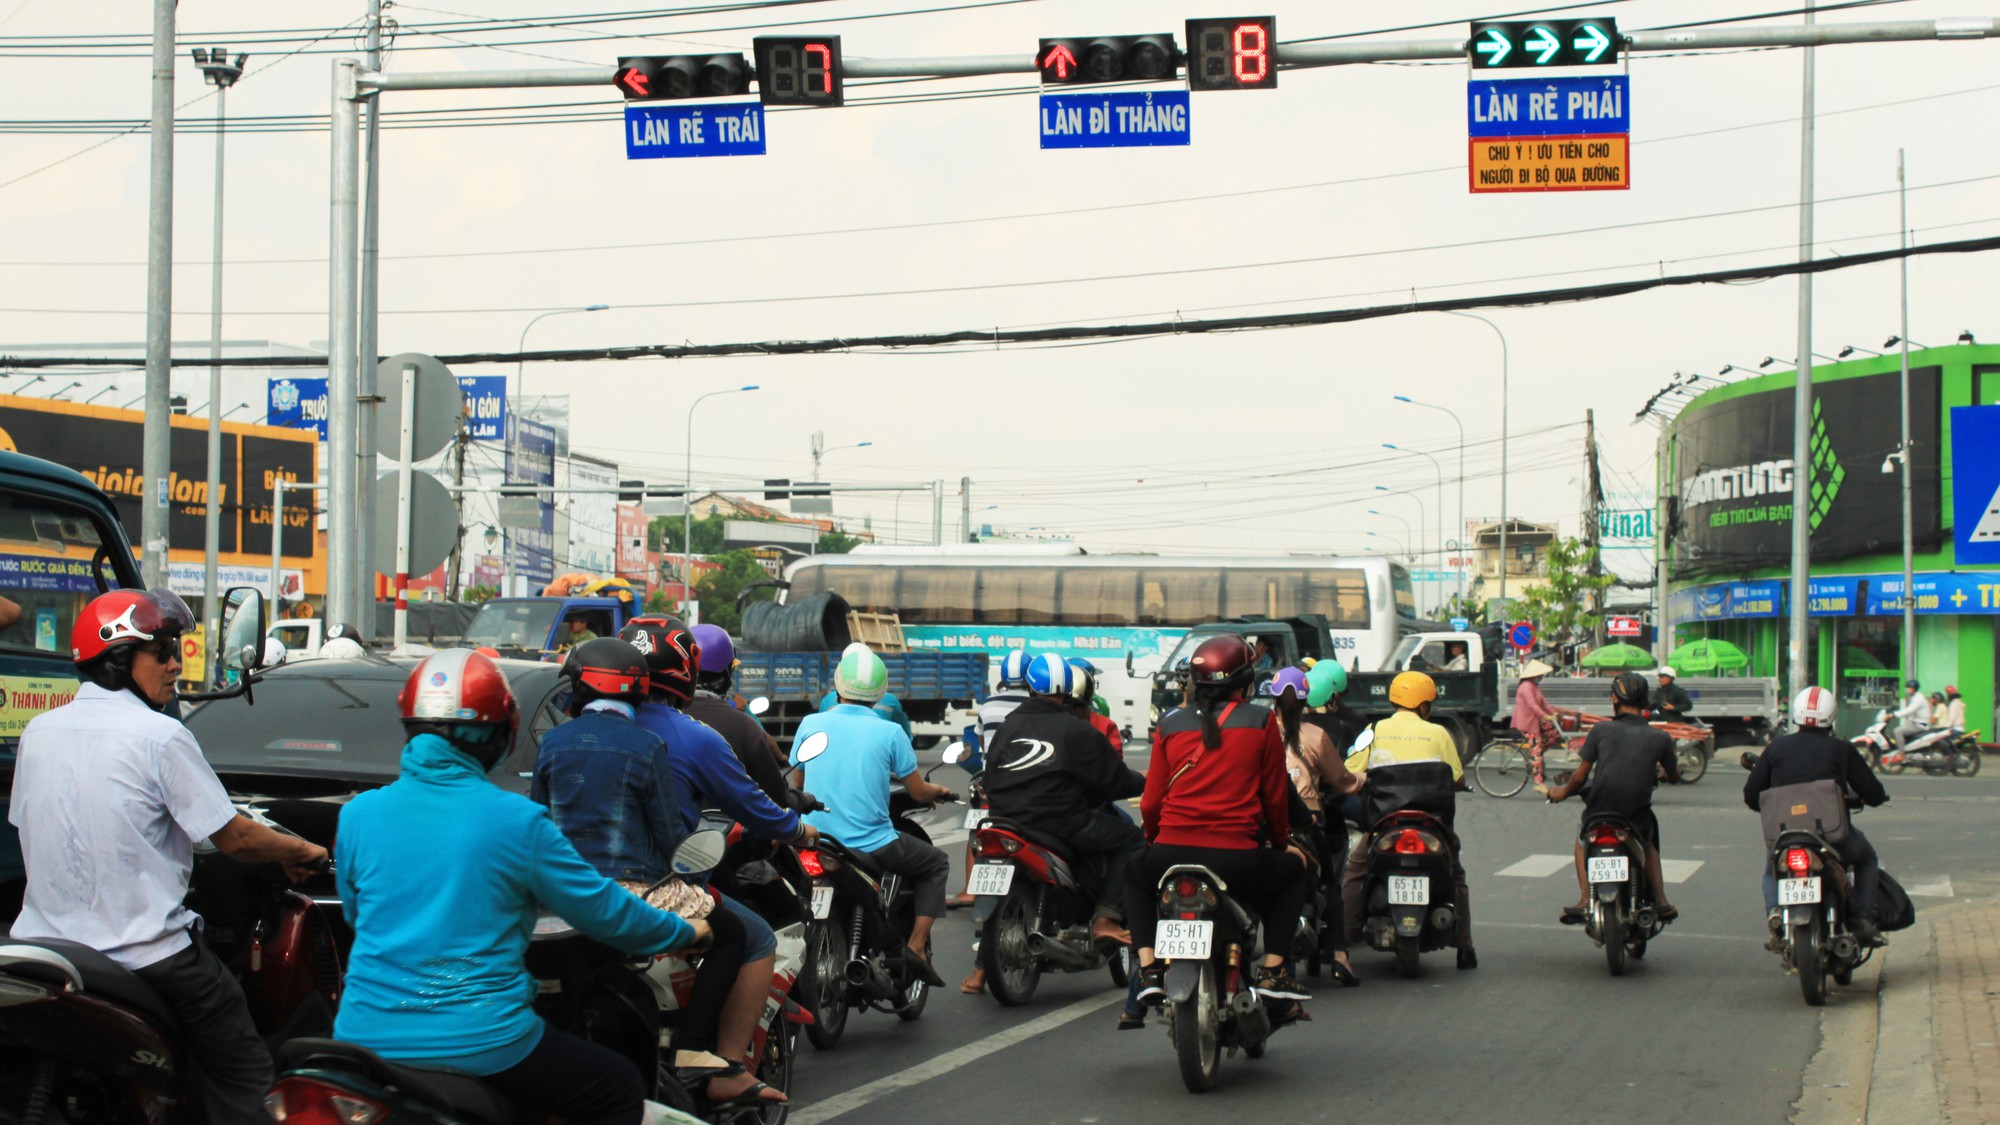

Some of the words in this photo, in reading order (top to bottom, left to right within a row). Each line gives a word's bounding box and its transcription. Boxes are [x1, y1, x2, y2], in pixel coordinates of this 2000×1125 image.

[1234, 24, 1267, 82] 8
[804, 44, 832, 93] 7
[1474, 86, 1518, 122] LÀN
[1529, 85, 1558, 121] RẼ
[1567, 79, 1622, 120] PHẢI
[1042, 101, 1082, 135] LÀN
[1115, 92, 1186, 133] THẲNG
[632, 112, 670, 146] LÀN
[679, 111, 705, 144] RẼ
[715, 108, 760, 143] TRÁI
[1488, 143, 1510, 161] CHÚ
[1515, 142, 1523, 161] Ý
[1537, 143, 1553, 160] ƯU
[1558, 141, 1582, 159] TIÊN
[1587, 142, 1610, 158] CHO
[1480, 165, 1513, 184] NGƯỜI
[1519, 168, 1530, 183] ĐI
[1535, 165, 1550, 186] BỘ
[1555, 167, 1576, 184] QUA
[1582, 163, 1620, 182] ĐƯỜNG
[477, 391, 500, 419] GÒN
[12, 689, 47, 709] THÀNH
[976, 881, 1004, 893] 1002
[1396, 891, 1423, 902] 1818
[1785, 891, 1815, 902] 1989
